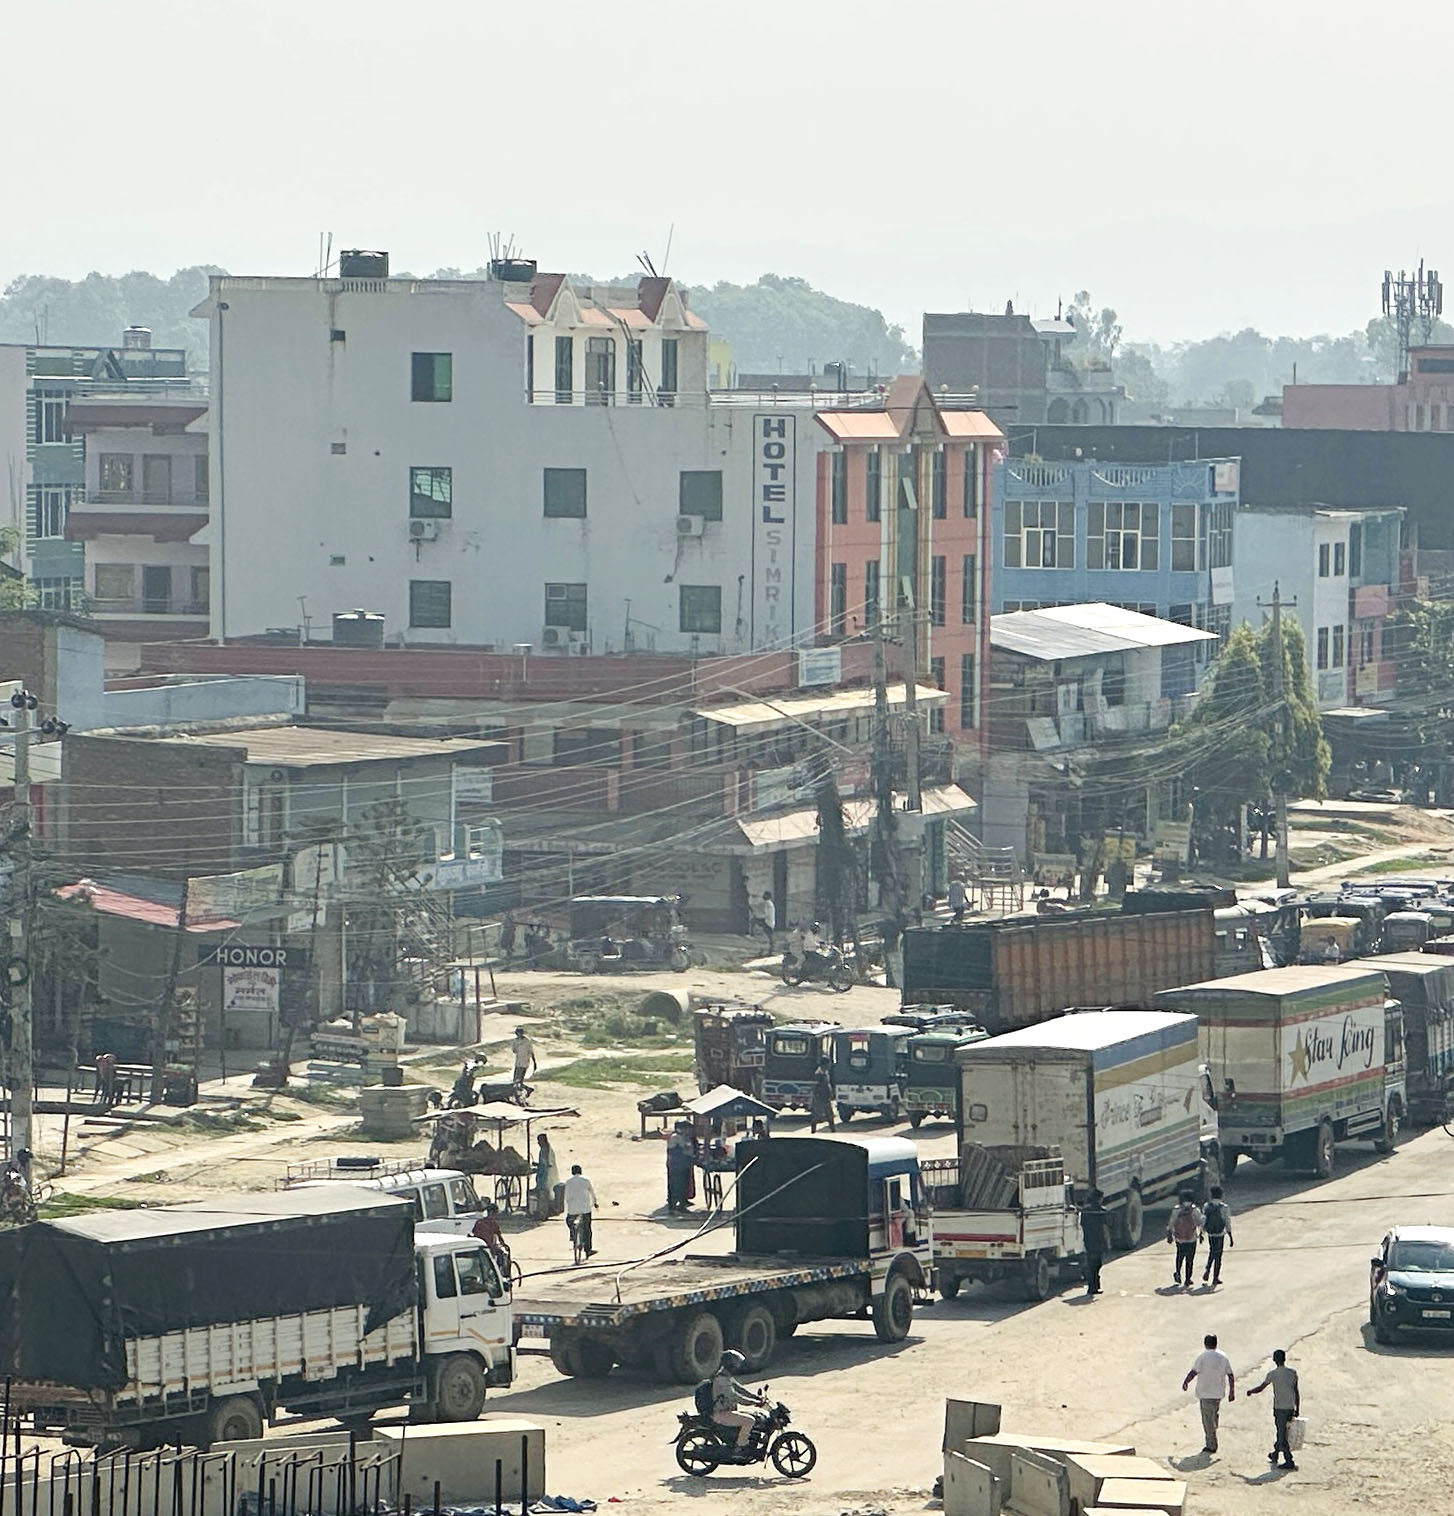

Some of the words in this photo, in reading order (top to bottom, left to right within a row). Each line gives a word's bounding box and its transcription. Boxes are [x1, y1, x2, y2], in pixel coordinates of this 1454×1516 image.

[762, 418, 786, 524] HOTEL
[764, 529, 783, 640] SIMRIK
[216, 947, 287, 966] HONOR
[1304, 1026, 1333, 1075] Star
[1337, 1014, 1375, 1071] King
